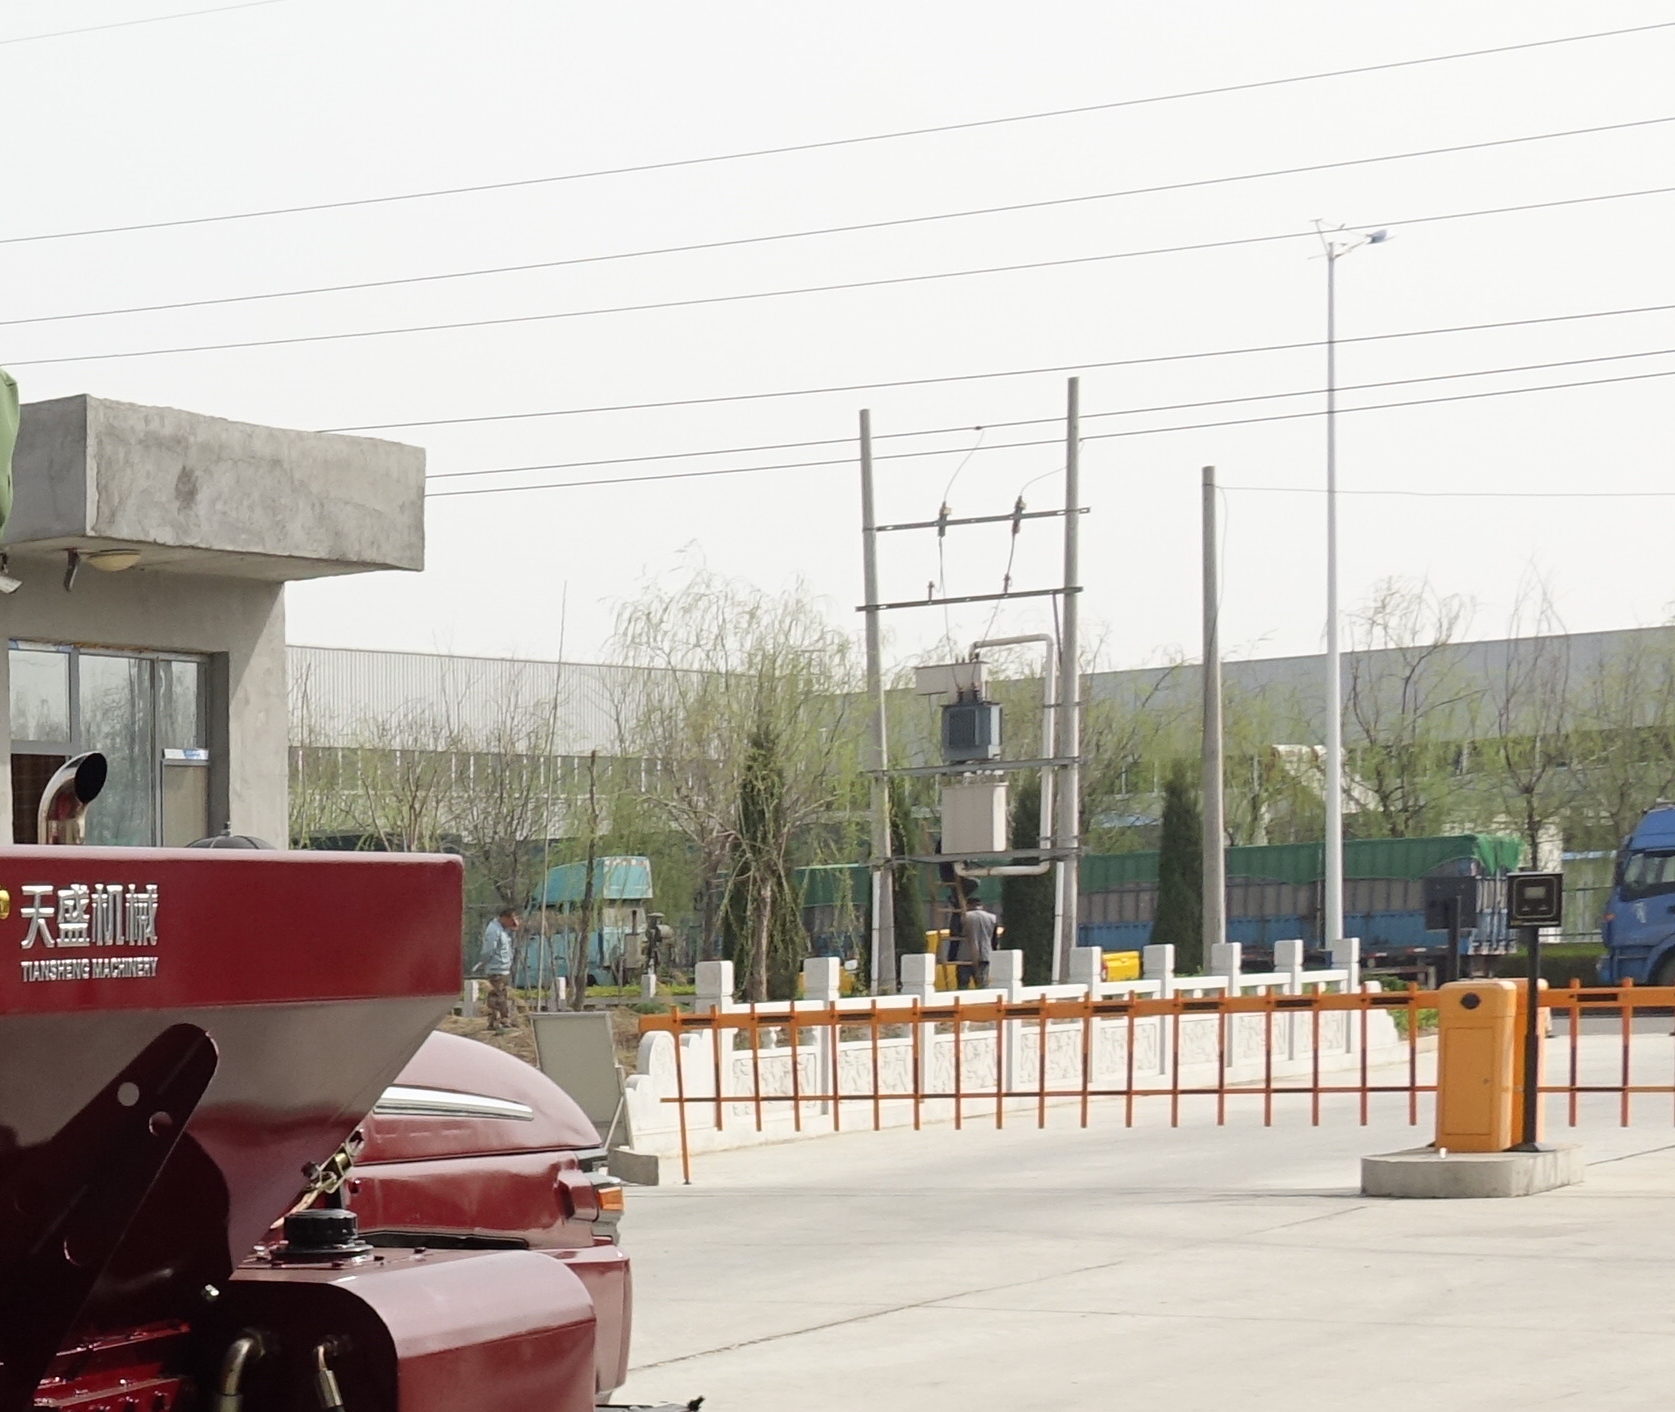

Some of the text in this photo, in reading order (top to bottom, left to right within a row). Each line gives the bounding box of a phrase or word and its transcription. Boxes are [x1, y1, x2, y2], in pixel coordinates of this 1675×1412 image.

[20, 883, 158, 949] 天盛机械
[20, 956, 159, 982] TIANSHENG MACHINERY
